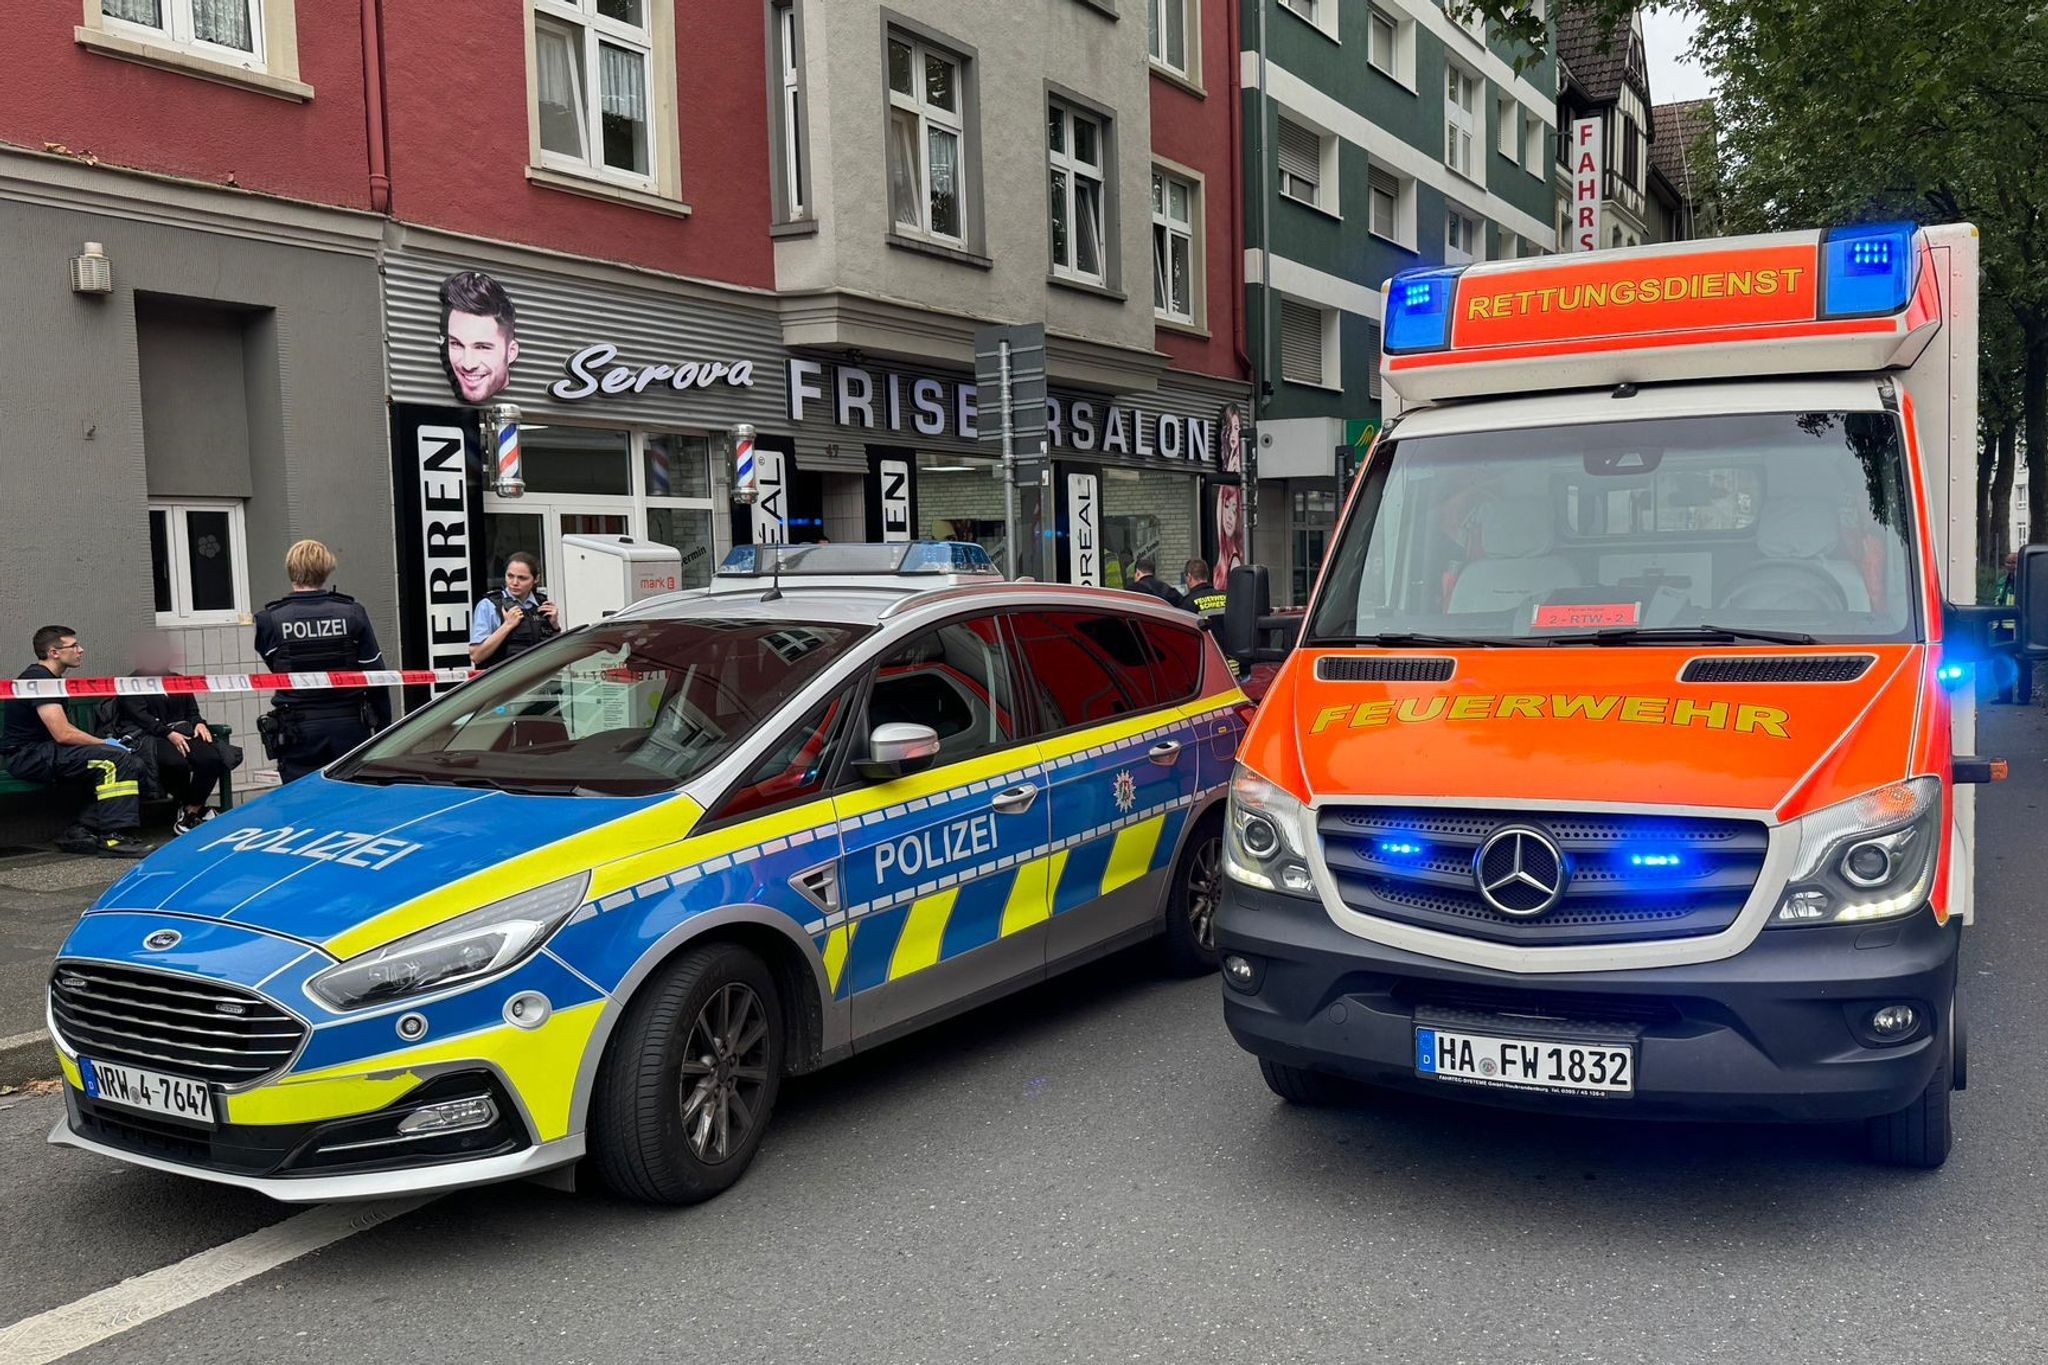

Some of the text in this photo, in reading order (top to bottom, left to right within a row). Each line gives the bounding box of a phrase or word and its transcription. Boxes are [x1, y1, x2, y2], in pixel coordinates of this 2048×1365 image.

[1468, 267, 1803, 320] RETTUNGSDIENST
[551, 343, 754, 399] Serova
[786, 358, 1209, 462] FRISERSALON
[884, 472, 907, 532] EN
[640, 577, 665, 588] mark
[282, 618, 347, 639] POLIZEI
[1549, 615, 1558, 624] 2
[1570, 614, 1603, 624] RTW
[1616, 614, 1624, 623] 2
[1309, 693, 1791, 738] FEUERWEHR
[197, 827, 424, 870] POLIZEI
[876, 813, 997, 884] POLIZEI
[1438, 1036, 1475, 1072] HA
[1500, 1043, 1539, 1079] FW
[1547, 1048, 1628, 1085] 1832
[93, 1064, 131, 1101] NRW
[139, 1074, 208, 1117] 4-7647
